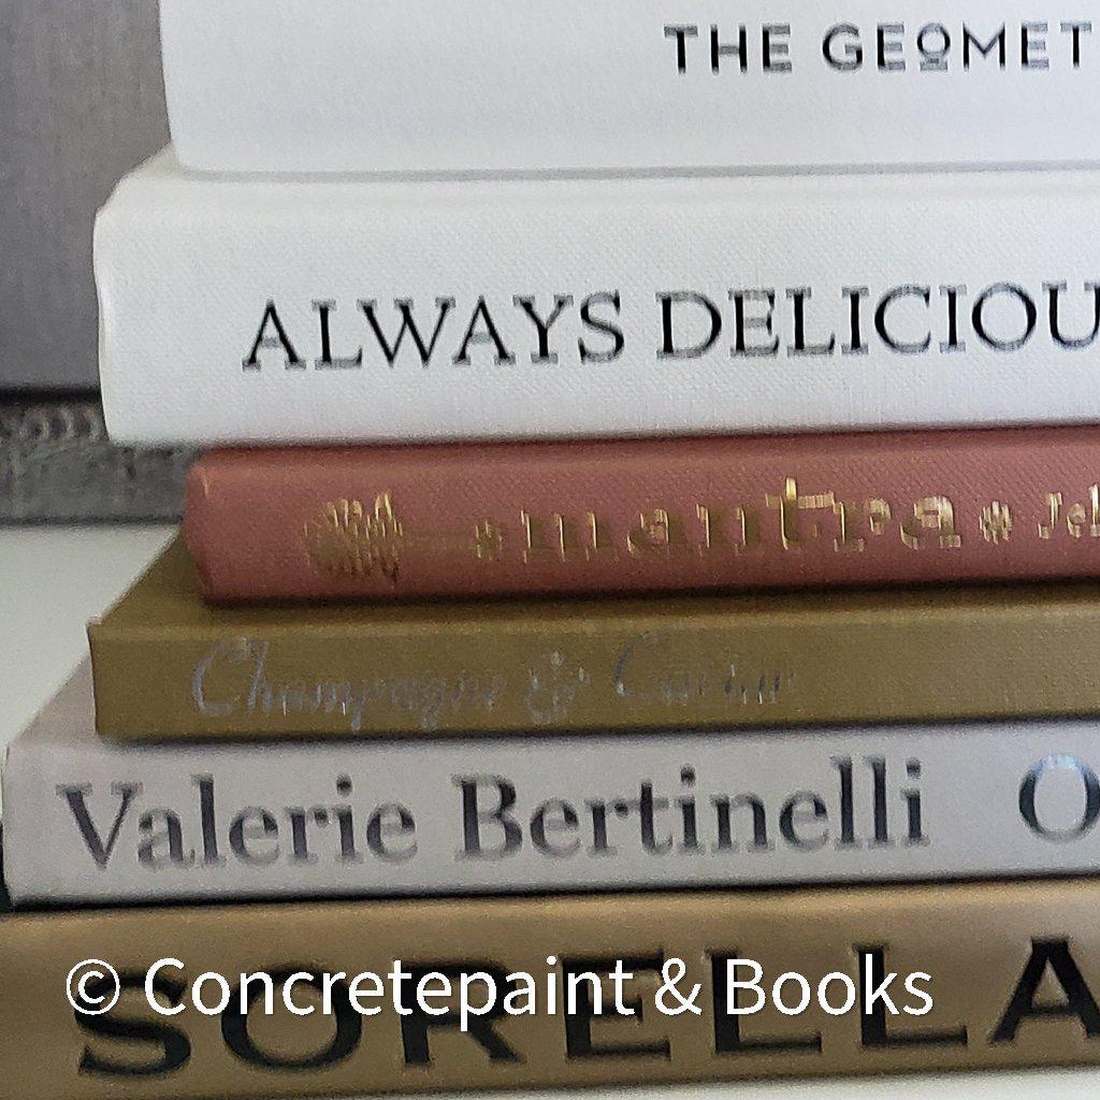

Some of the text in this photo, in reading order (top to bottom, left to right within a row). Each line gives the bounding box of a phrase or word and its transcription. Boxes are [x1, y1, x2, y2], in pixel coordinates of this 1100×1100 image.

[664, 23, 793, 77] THE
[242, 289, 626, 372] ALWAYS
[58, 756, 930, 873] Valerie Bertinelli
